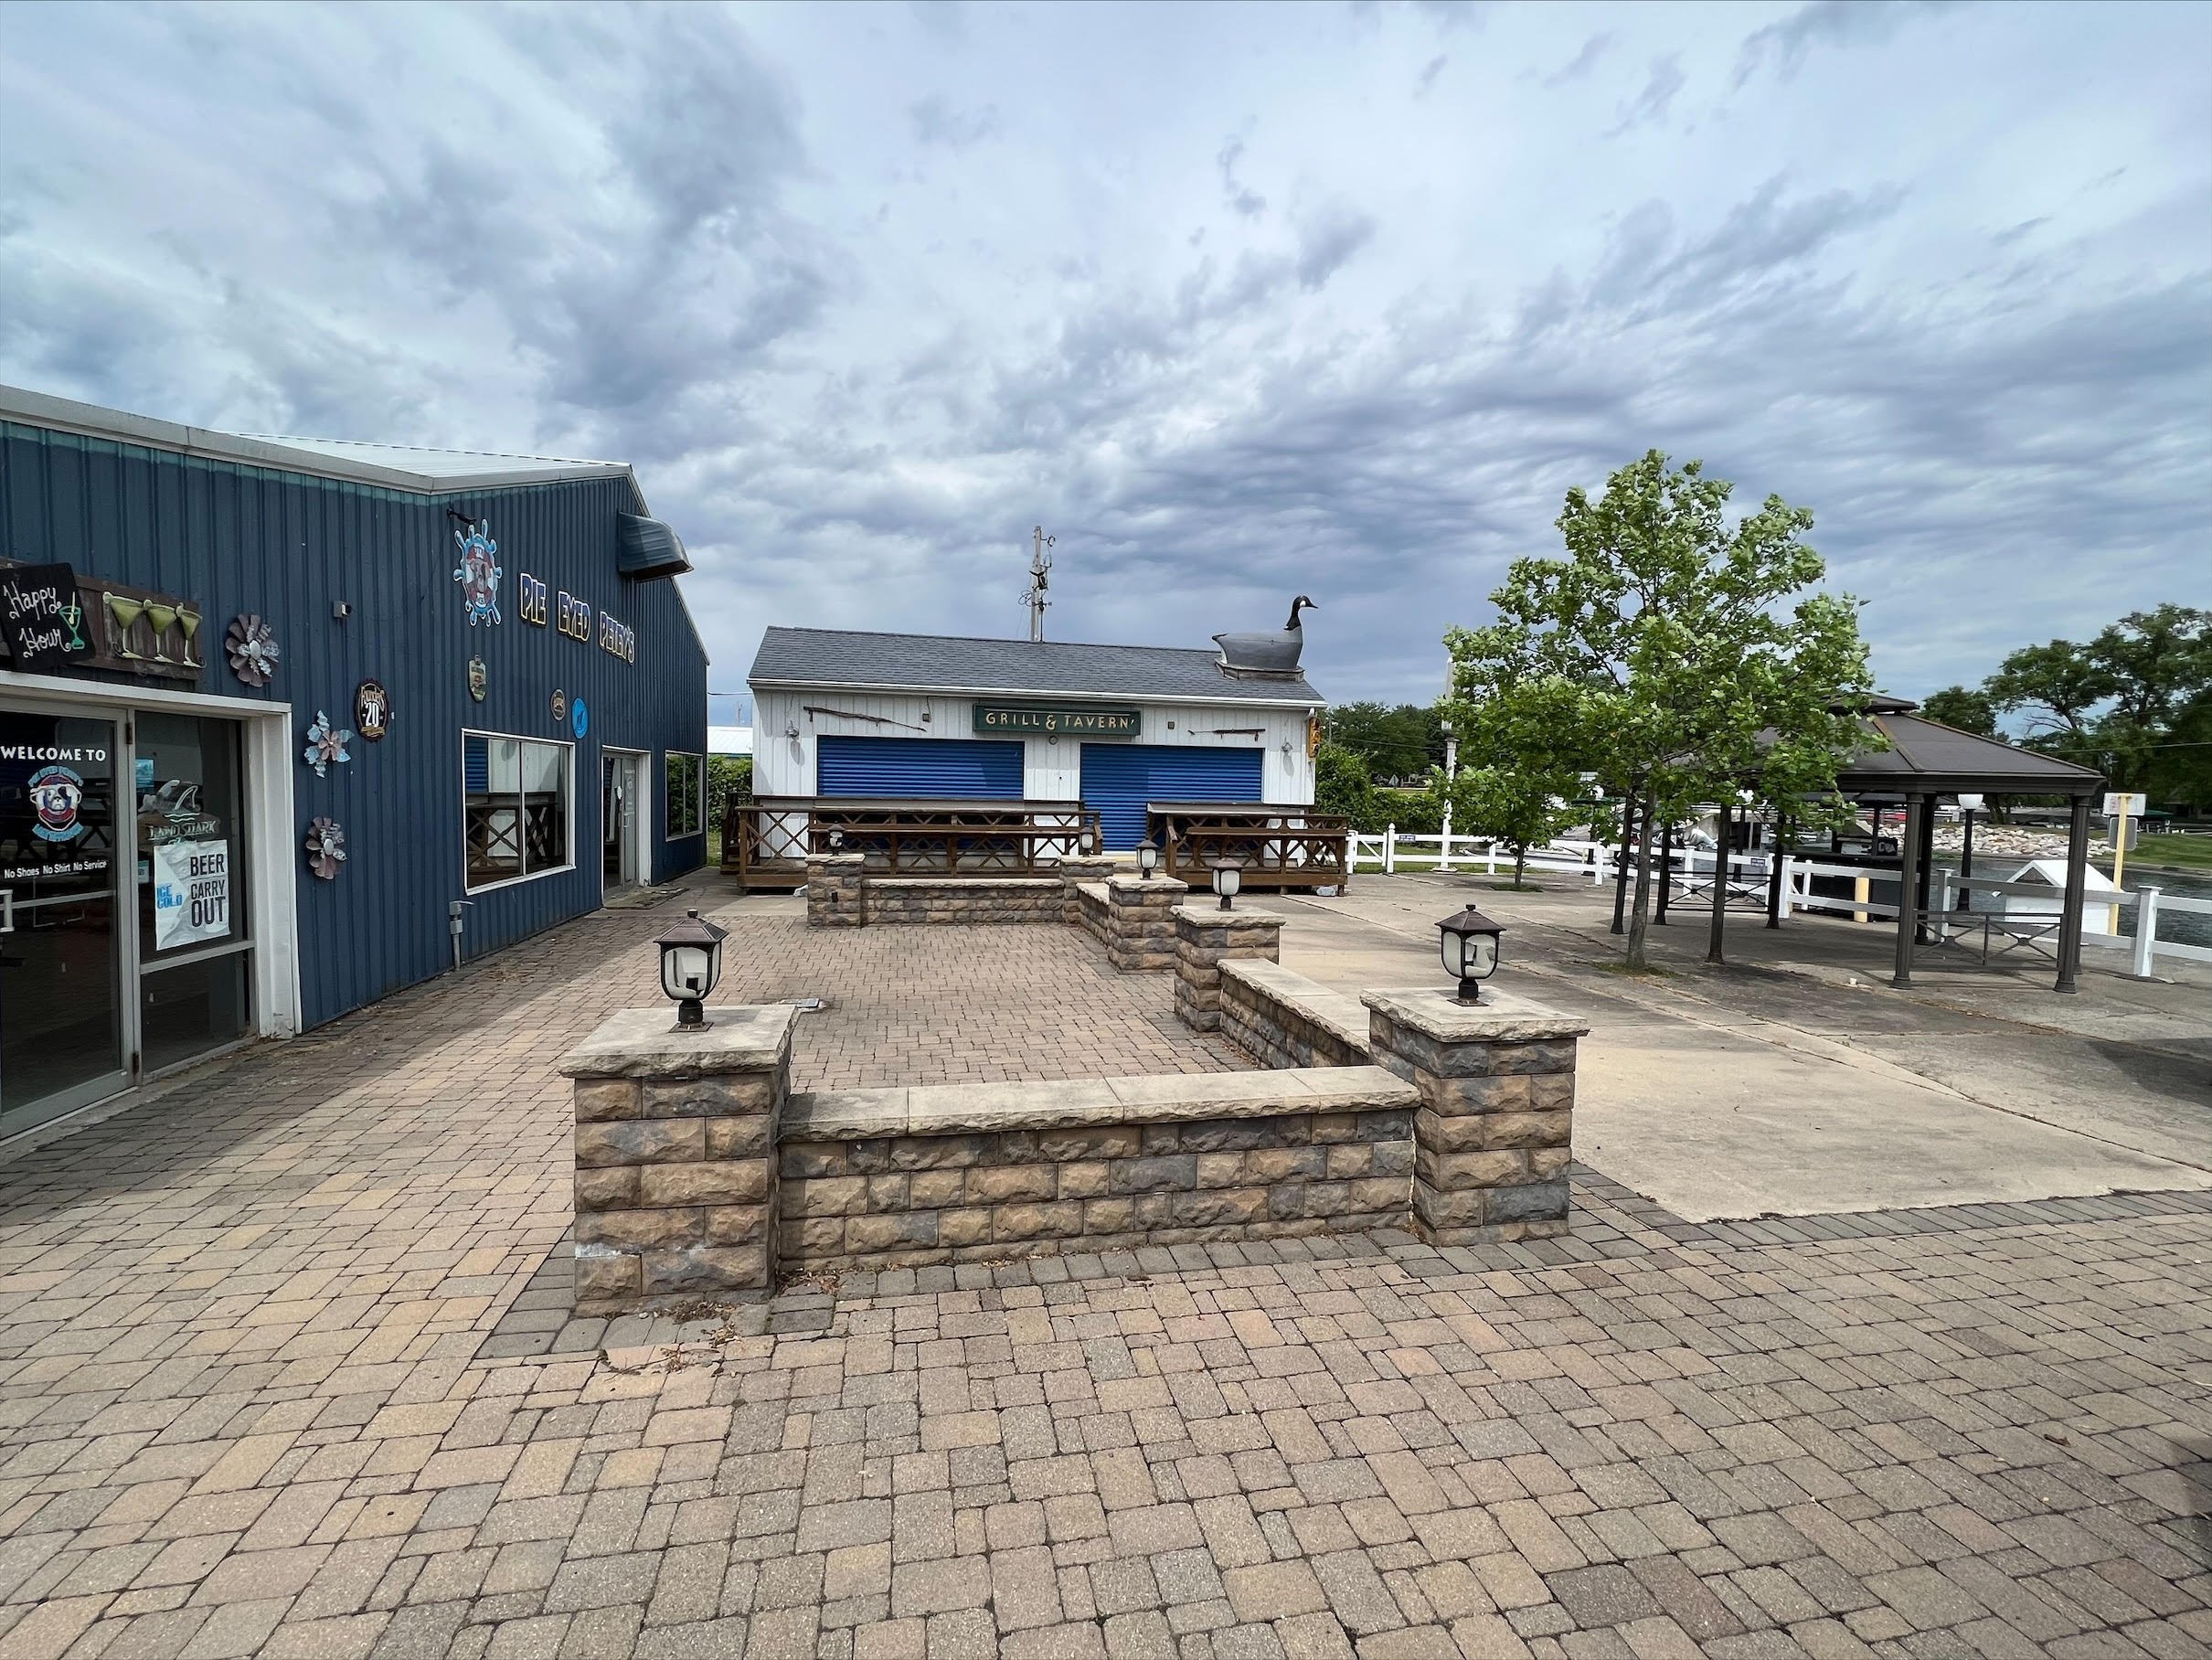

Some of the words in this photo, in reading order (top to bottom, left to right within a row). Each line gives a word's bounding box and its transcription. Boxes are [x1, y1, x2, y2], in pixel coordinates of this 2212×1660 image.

[3, 580, 62, 621] Happy
[520, 572, 547, 625] PIE
[558, 591, 590, 642] EYED
[19, 628, 71, 658] Hour
[366, 702, 379, 728] 20
[985, 713, 1039, 726] GRILL
[1046, 715, 1057, 730] &
[0, 746, 82, 761] WELCOME
[86, 750, 106, 761] TO
[4, 869, 16, 879] No
[16, 867, 40, 878] Shoes
[42, 865, 53, 875] No
[54, 864, 71, 873] Shirt
[73, 862, 83, 871] No
[83, 859, 107, 870] Service
[190, 853, 225, 878] BEER
[156, 884, 173, 898] ICE
[190, 879, 225, 900] CARRY
[157, 894, 183, 910] COLD
[191, 896, 227, 928] OUT
